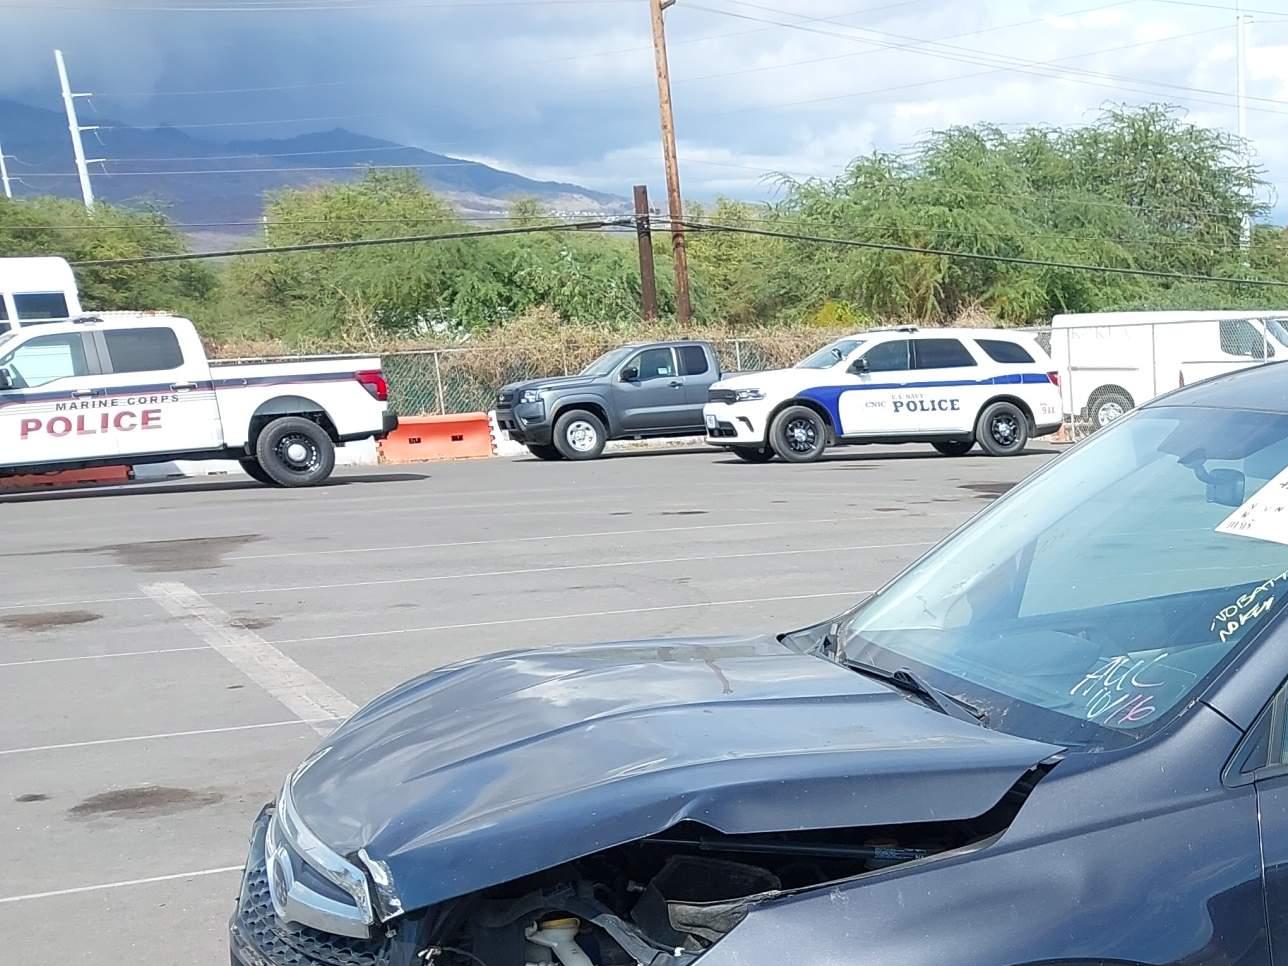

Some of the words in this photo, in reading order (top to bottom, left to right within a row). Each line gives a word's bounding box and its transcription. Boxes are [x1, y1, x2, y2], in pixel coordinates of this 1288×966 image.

[55, 399, 119, 411] MARINE
[127, 395, 179, 406] CORPS
[892, 398, 960, 413] POLICE
[20, 408, 162, 440] POLICE
